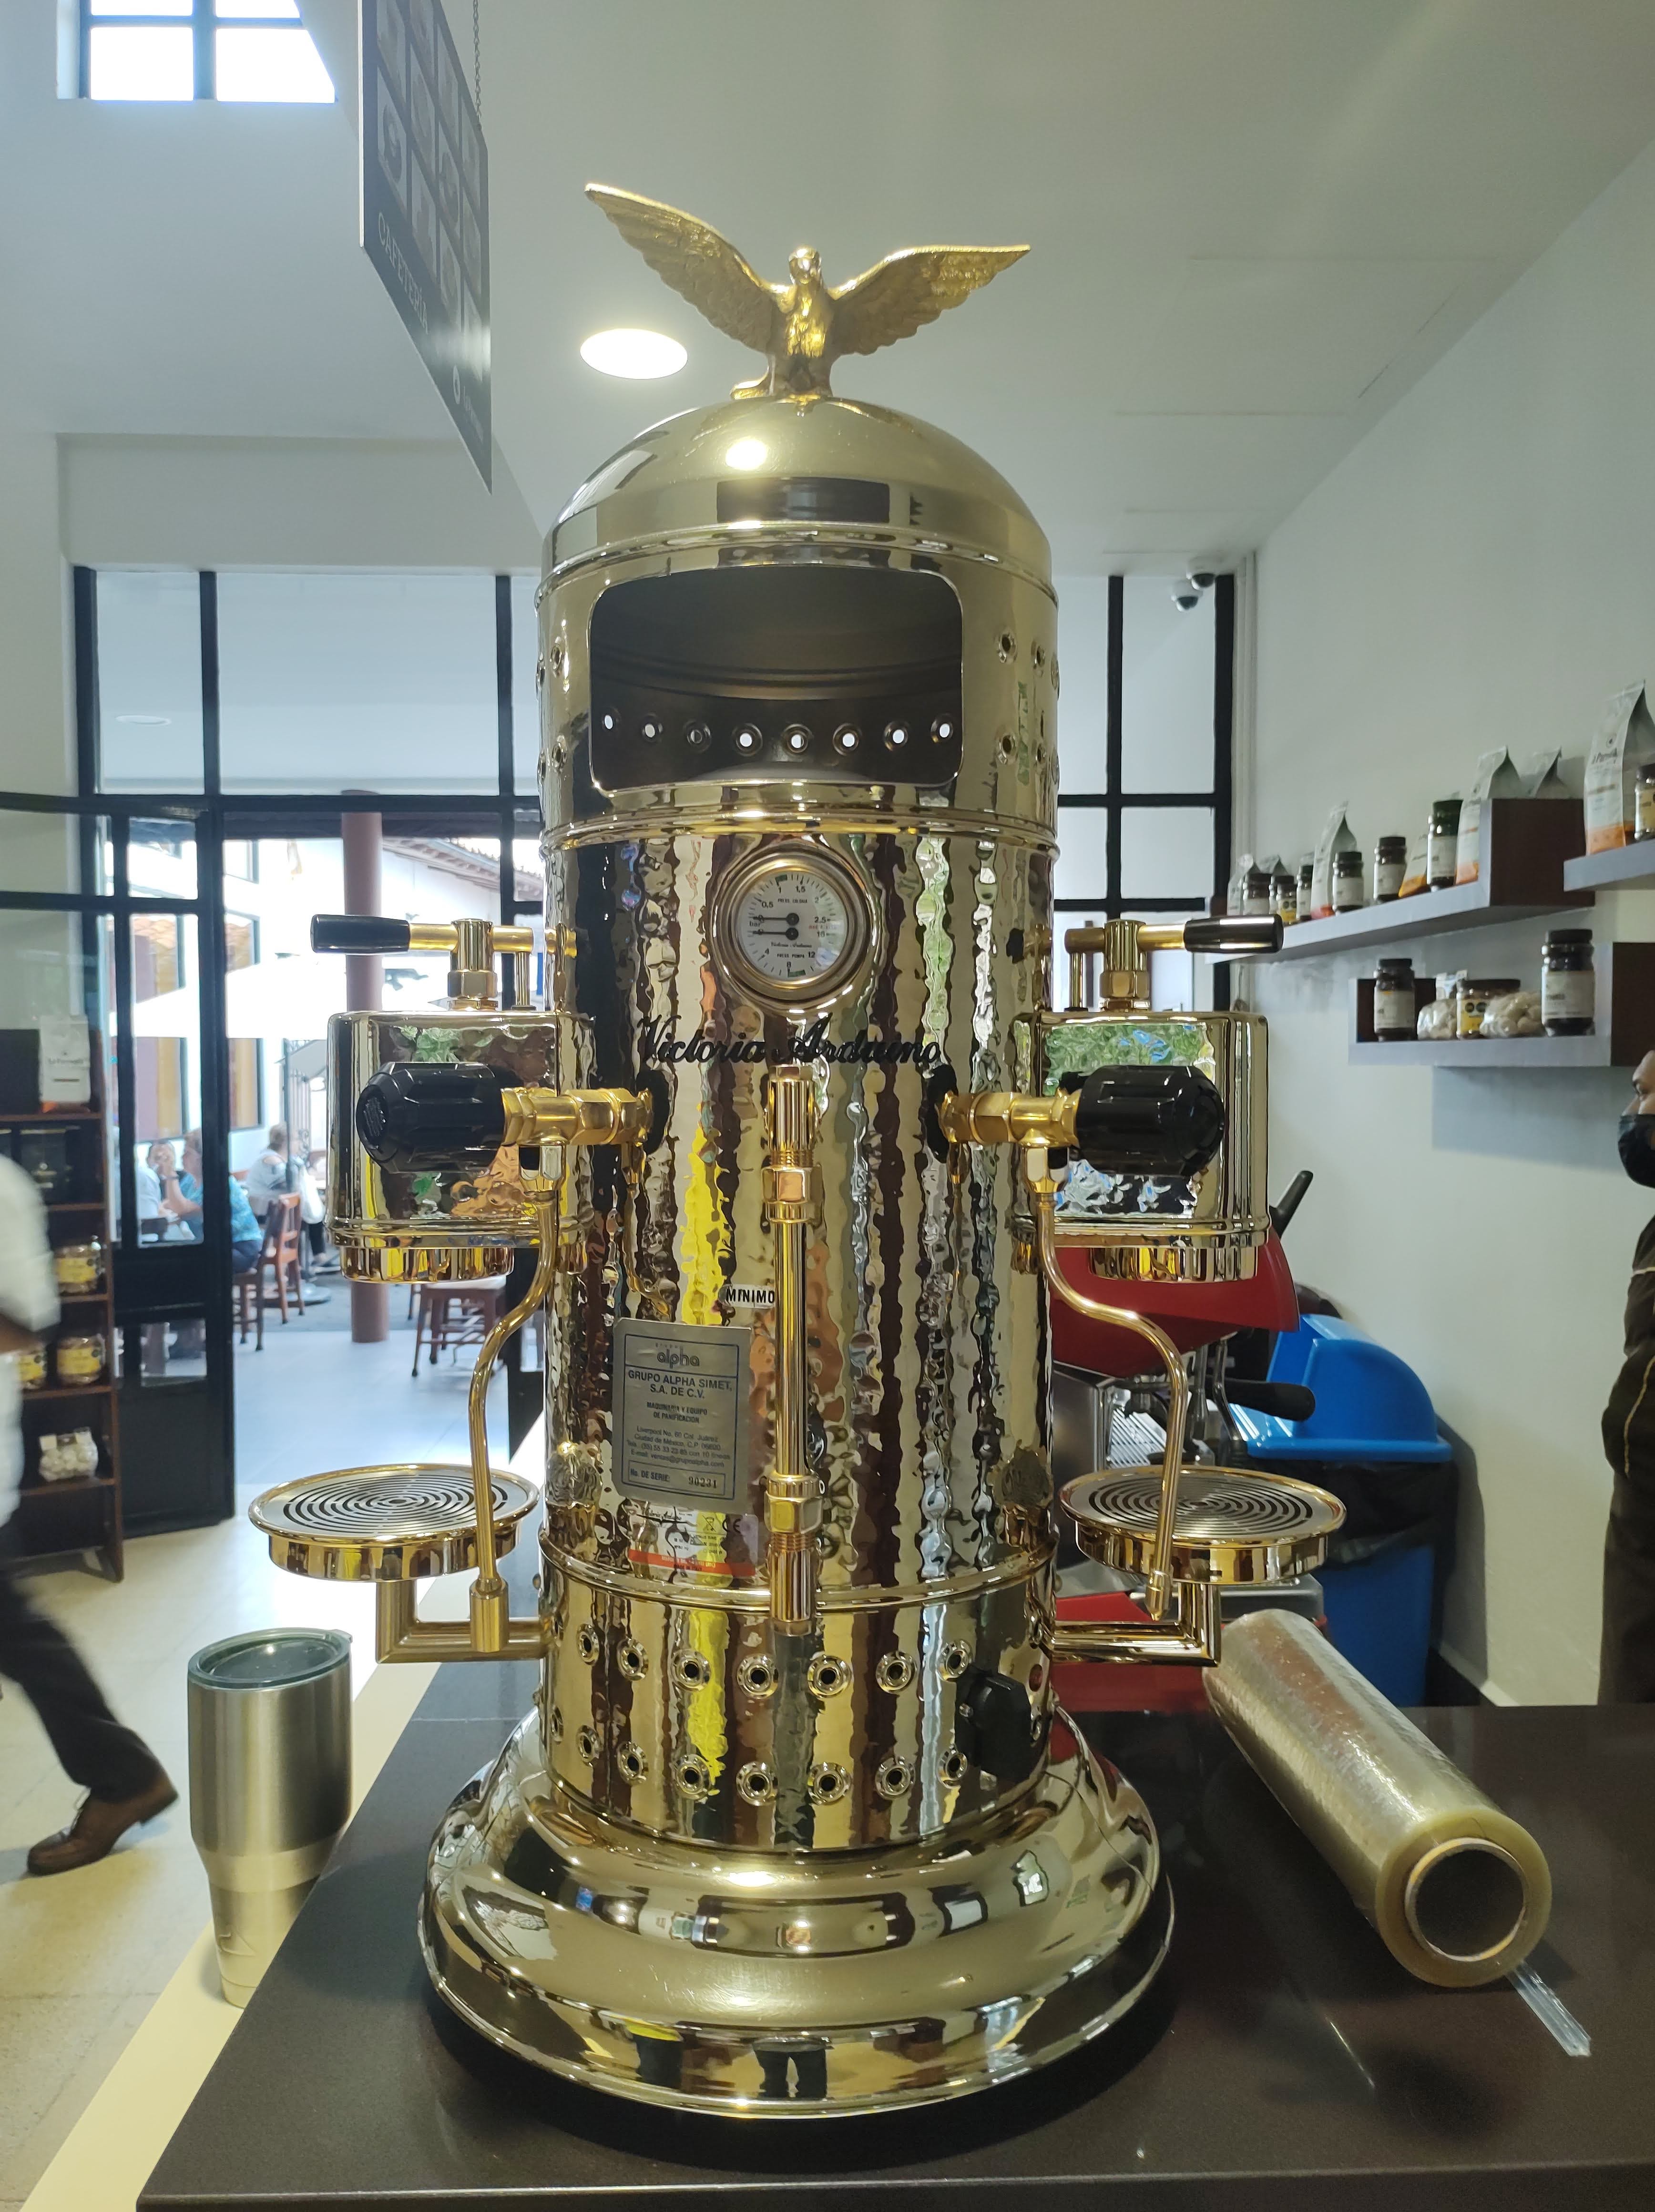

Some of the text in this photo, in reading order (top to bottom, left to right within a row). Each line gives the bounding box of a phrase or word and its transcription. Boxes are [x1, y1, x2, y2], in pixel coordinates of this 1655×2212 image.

[638, 1014, 767, 1063] Victoria
[726, 1288, 775, 1303] MINIMO
[657, 1346, 699, 1369] alpha
[628, 1370, 660, 1382] GRUPO
[663, 1375, 695, 1387] ALPHA
[650, 1383, 705, 1399] S.A. DE C.V.
[647, 1402, 680, 1412] MAQUINARIA
[686, 1407, 707, 1415] EQUIPO
[641, 1470, 649, 1479] DE
[688, 1476, 717, 1489] 90231
